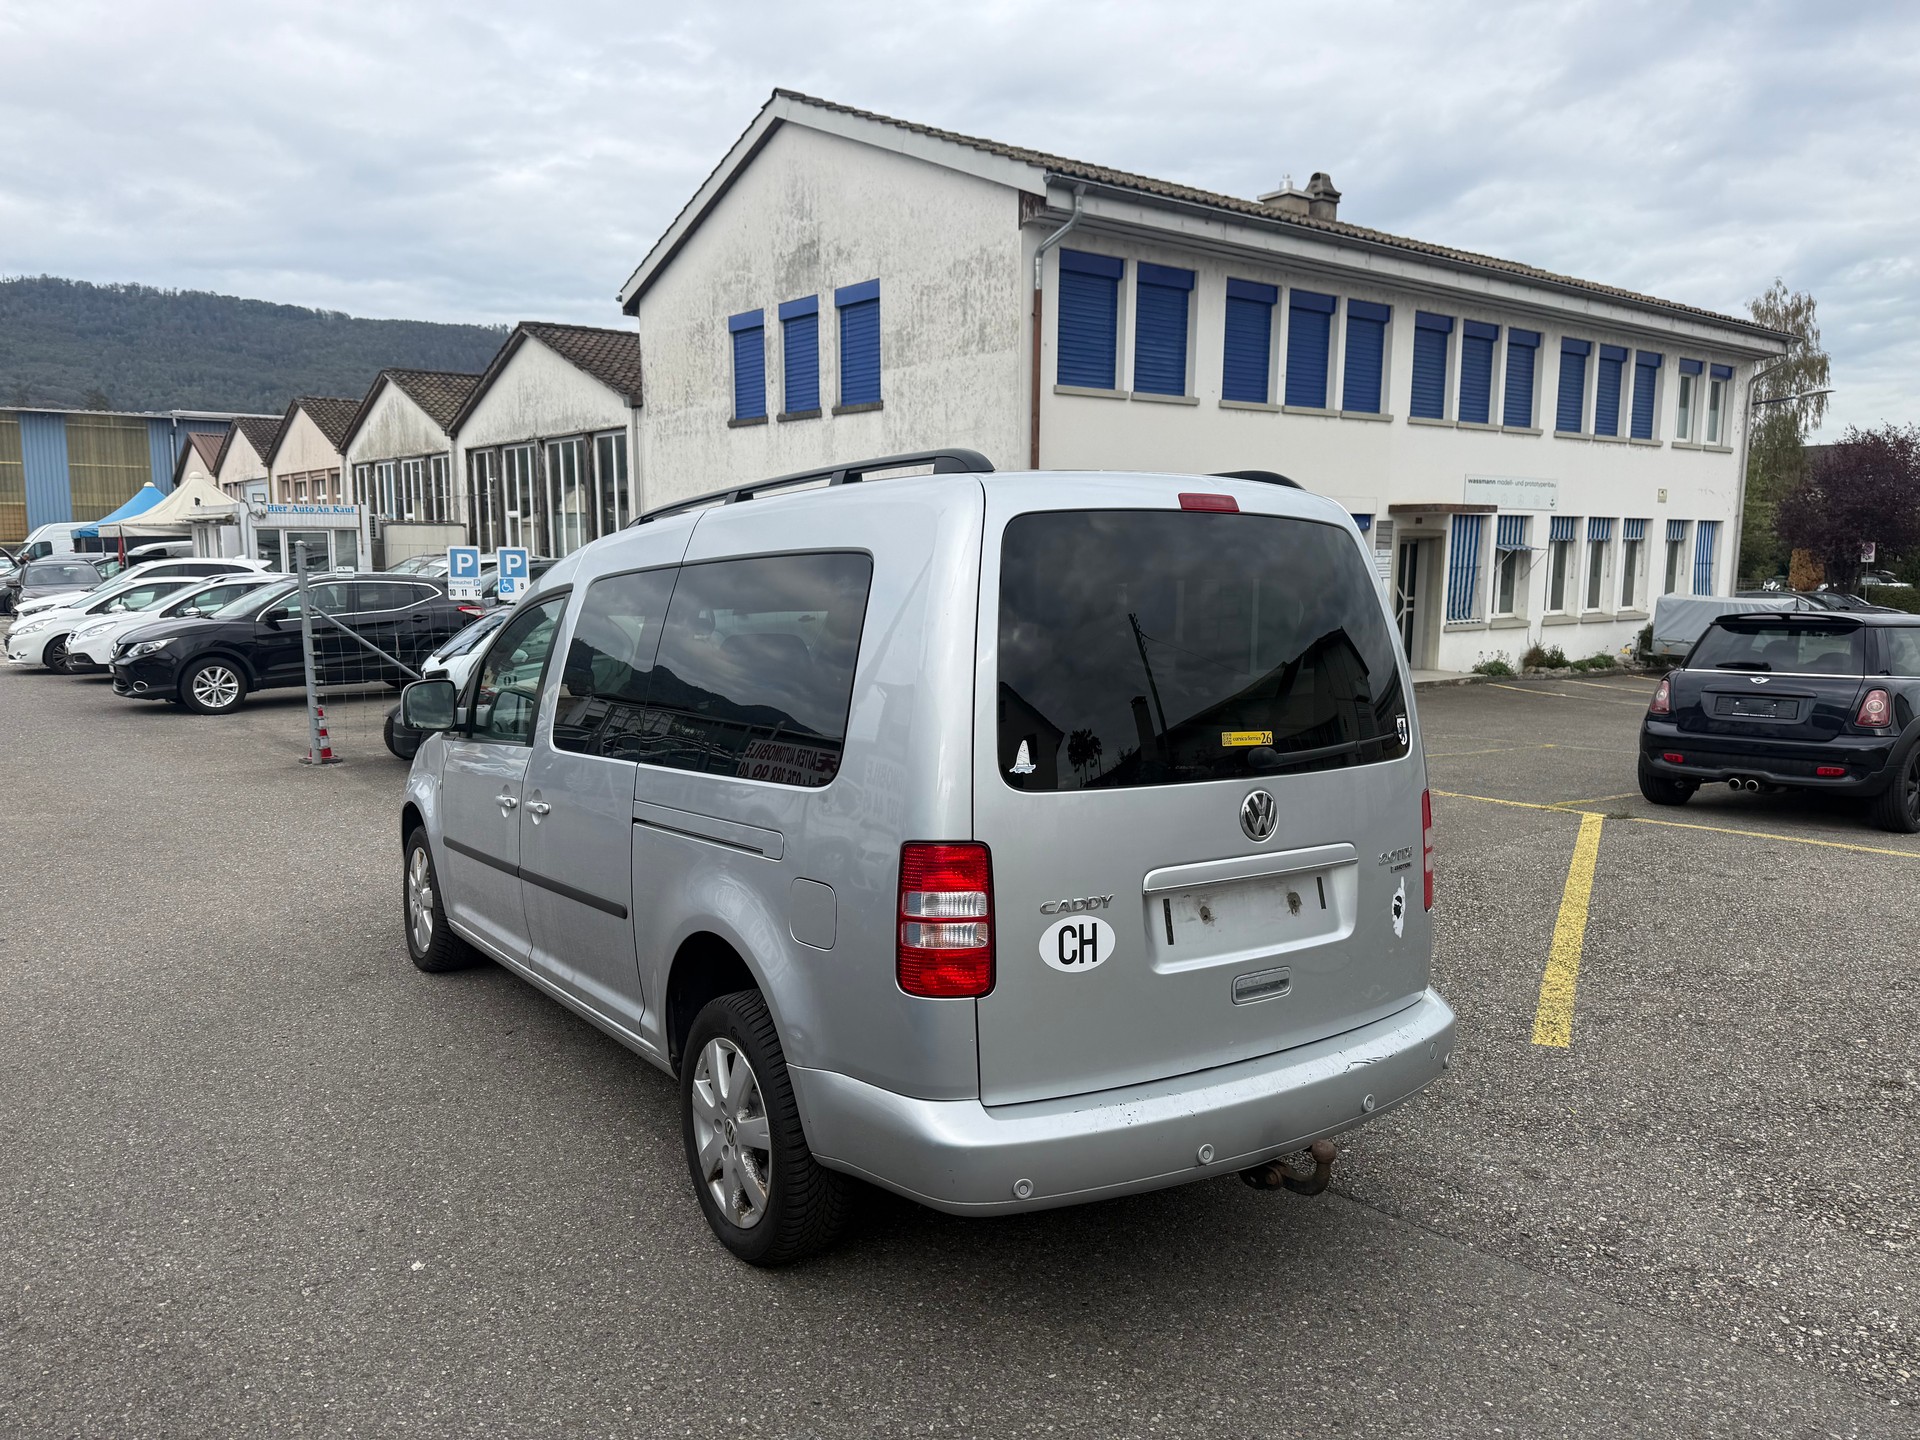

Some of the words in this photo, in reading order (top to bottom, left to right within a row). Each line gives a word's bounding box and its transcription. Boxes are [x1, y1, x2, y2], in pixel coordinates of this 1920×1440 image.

[267, 504, 288, 512] Hier
[291, 504, 314, 513] Auto
[316, 505, 330, 513] An
[333, 505, 355, 513] Kauf
[456, 553, 473, 574] P
[505, 554, 522, 575] P
[449, 589, 456, 597] 10
[461, 589, 468, 597] 11
[475, 589, 482, 597] 12
[520, 582, 525, 590] 9
[1261, 732, 1272, 744] 26
[1040, 893, 1114, 915] CADDY
[1058, 922, 1097, 965] CH
